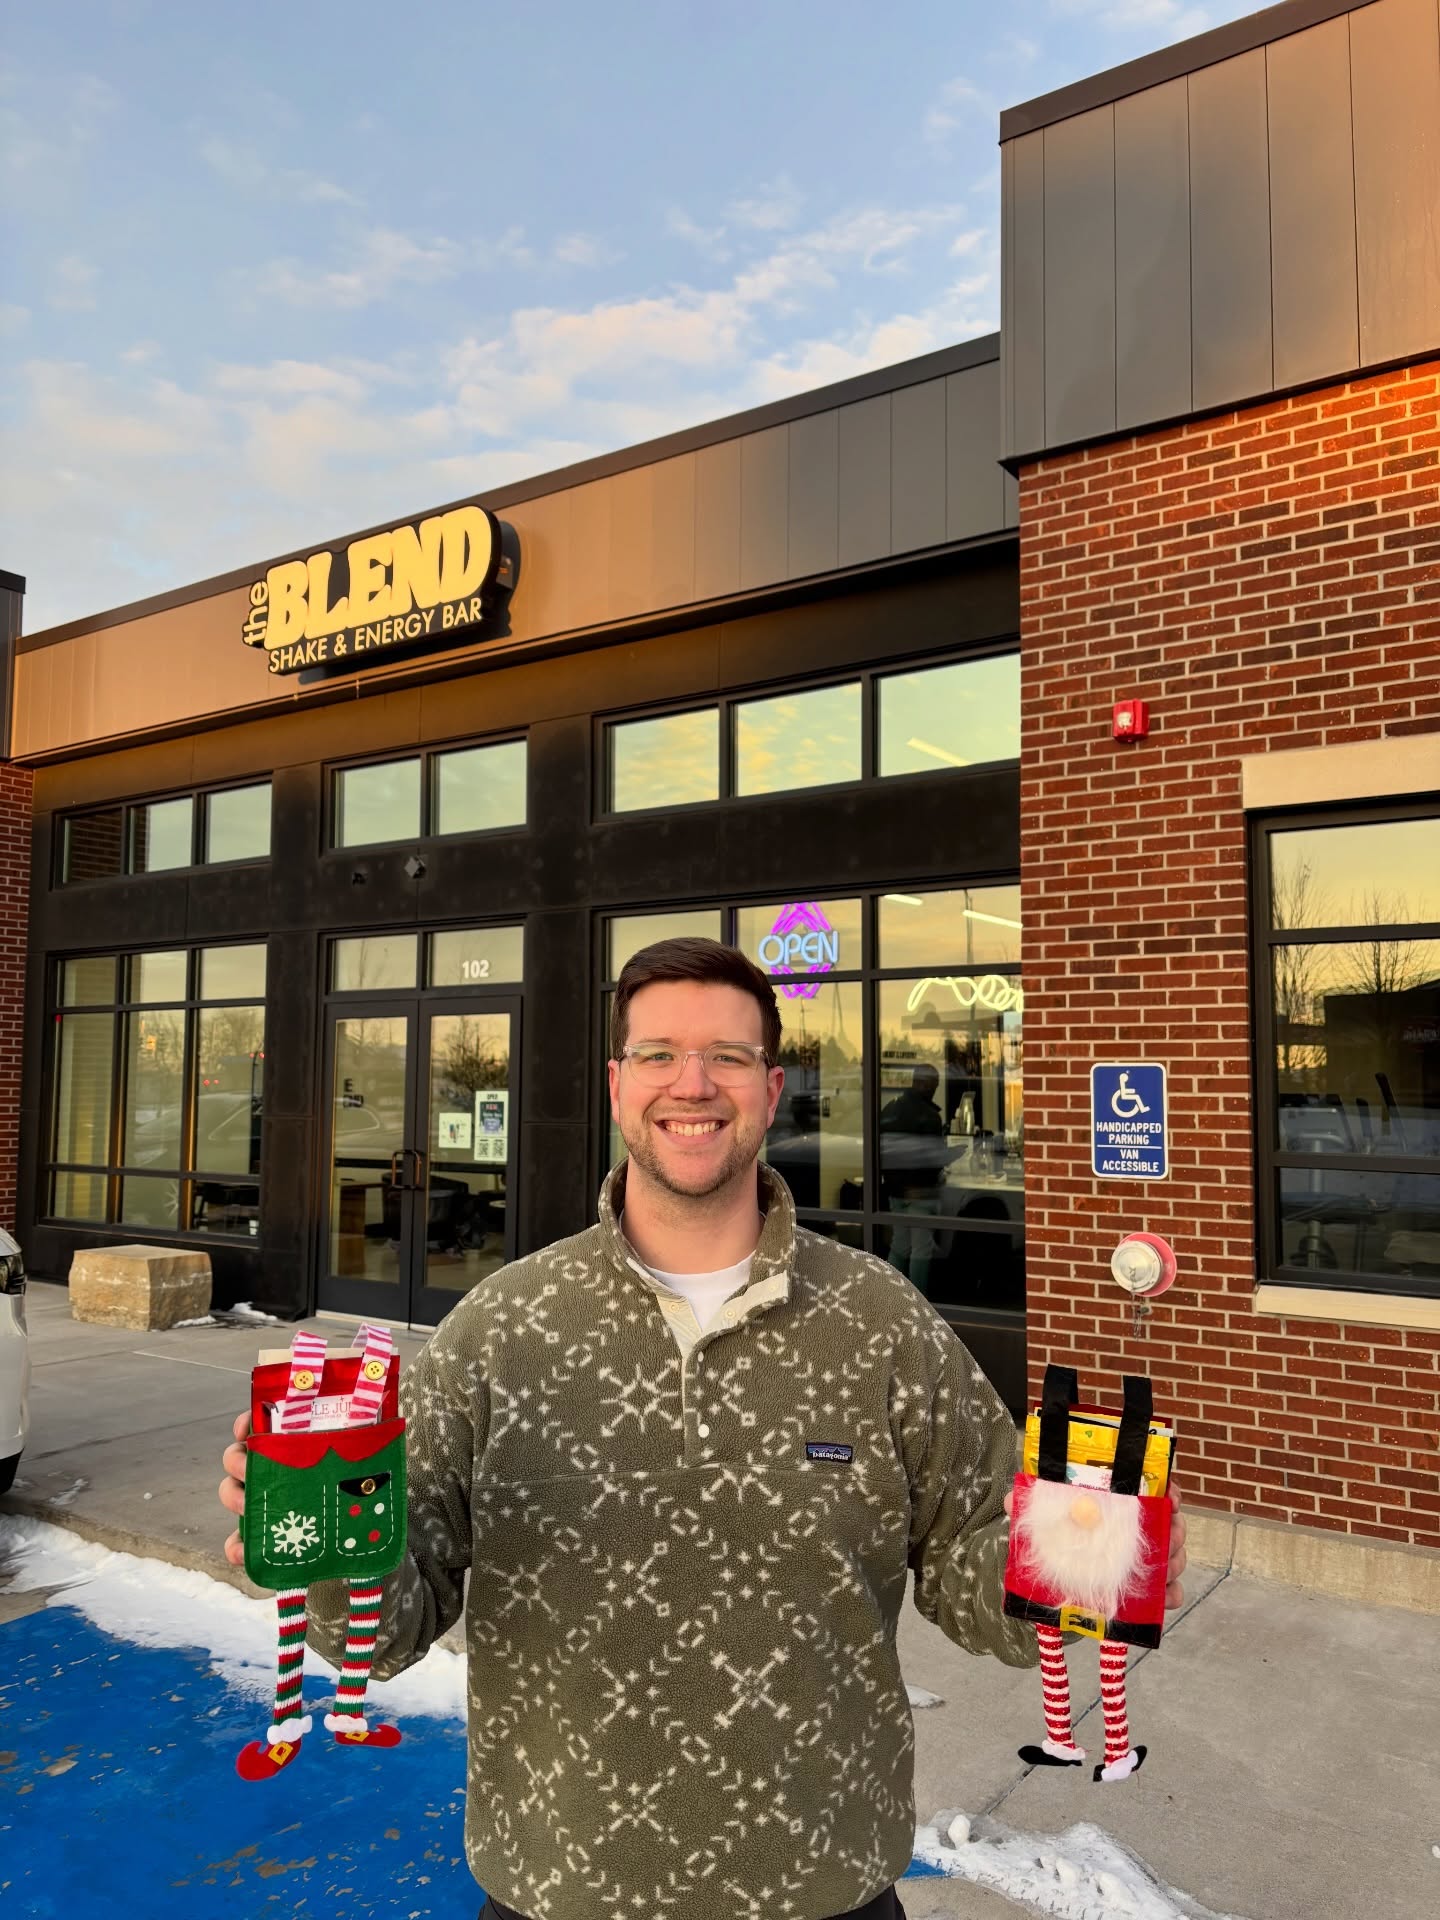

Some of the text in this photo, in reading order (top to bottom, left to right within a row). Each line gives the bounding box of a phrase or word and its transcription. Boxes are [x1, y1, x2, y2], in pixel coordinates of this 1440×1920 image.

[264, 505, 492, 650] BLEND
[243, 581, 268, 645] the
[269, 597, 483, 673] SHAKE & ENERGY BAR
[758, 930, 839, 966] OPEN
[462, 959, 489, 979] 102
[1096, 1121, 1162, 1134] HANDICAPPED
[1108, 1133, 1150, 1146] PARKING
[1120, 1149, 1139, 1160] VAN
[1102, 1160, 1160, 1173] ACCESSIBLE
[812, 1450, 849, 1460] patagonia
